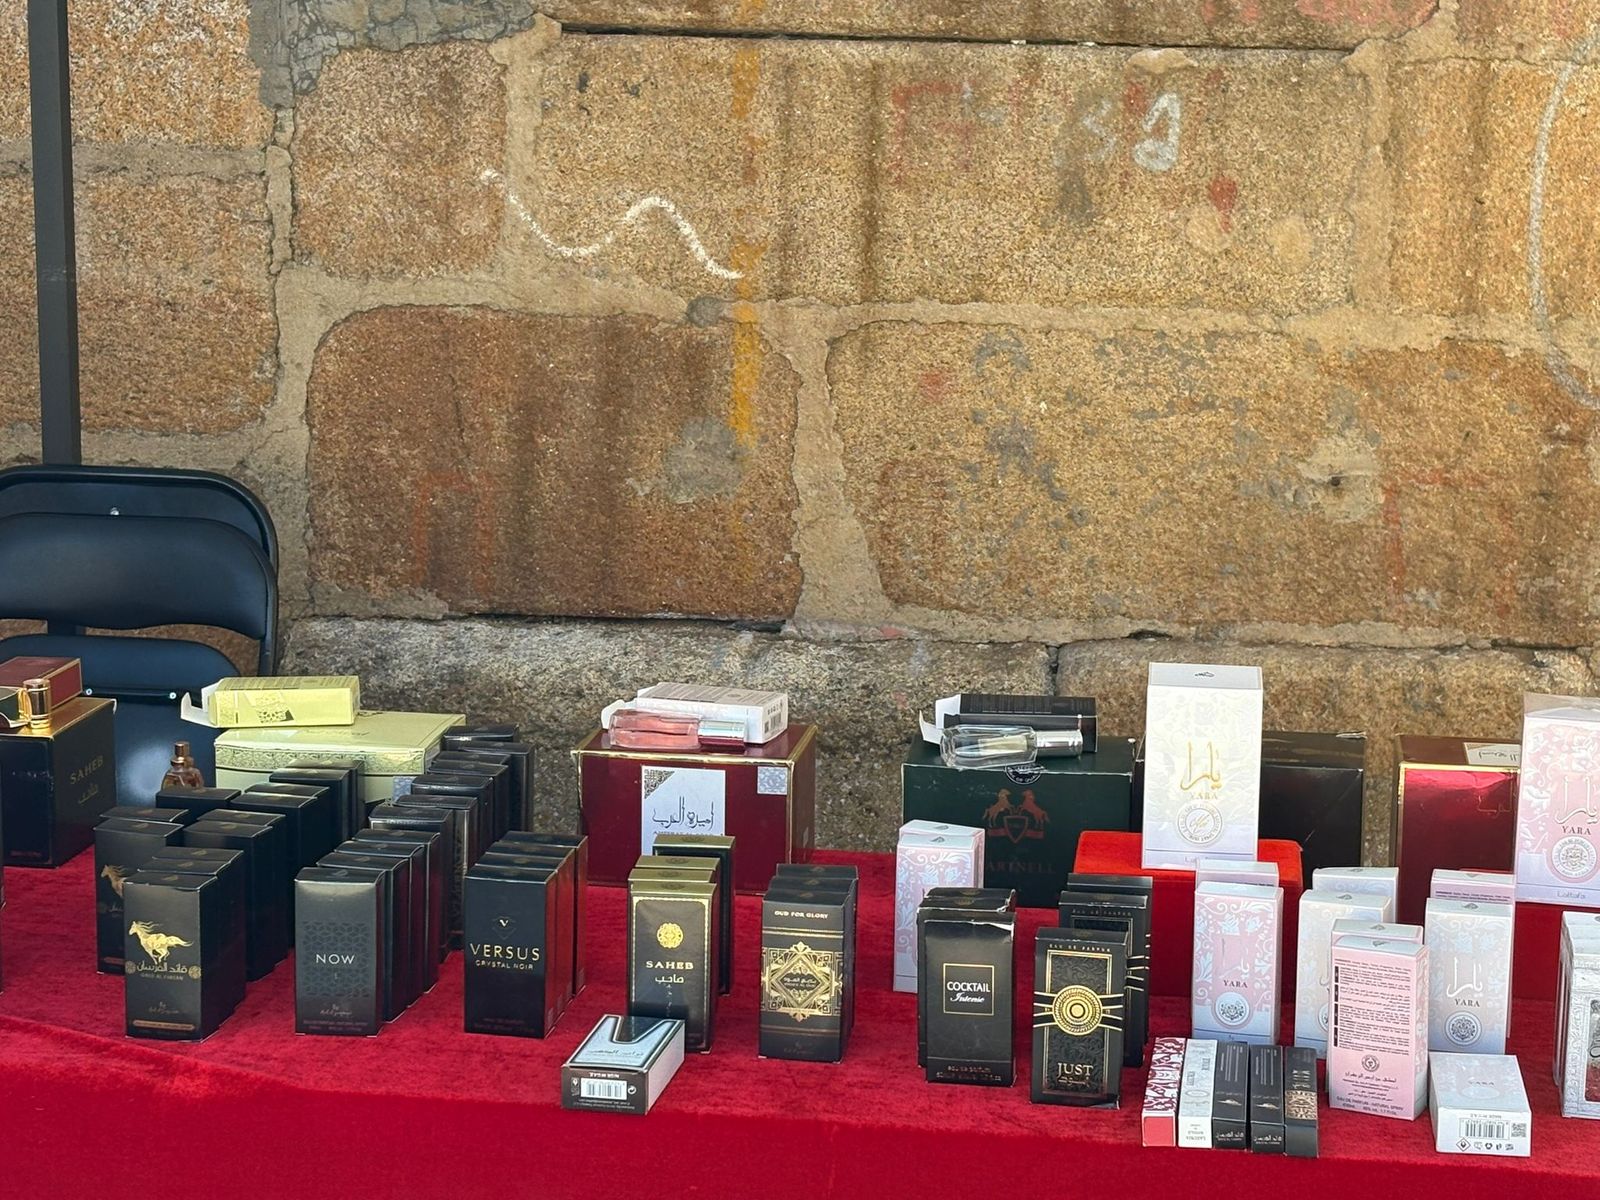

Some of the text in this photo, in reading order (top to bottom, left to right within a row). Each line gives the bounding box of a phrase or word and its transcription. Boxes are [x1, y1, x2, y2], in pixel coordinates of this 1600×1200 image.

[70, 755, 104, 785] SAHEB
[1562, 825, 1591, 836] YARA
[469, 943, 540, 961] VERSUS
[315, 953, 355, 965] NOW
[475, 960, 511, 969] CRYSTAL
[645, 960, 694, 970] SAHEB
[654, 973, 684, 985] صاحب
[1223, 979, 1248, 989] YARA
[946, 981, 991, 993] COCKTAIL
[949, 992, 985, 1003] Intense
[1454, 998, 1480, 1008] YARA
[1056, 1062, 1094, 1078] JUST
